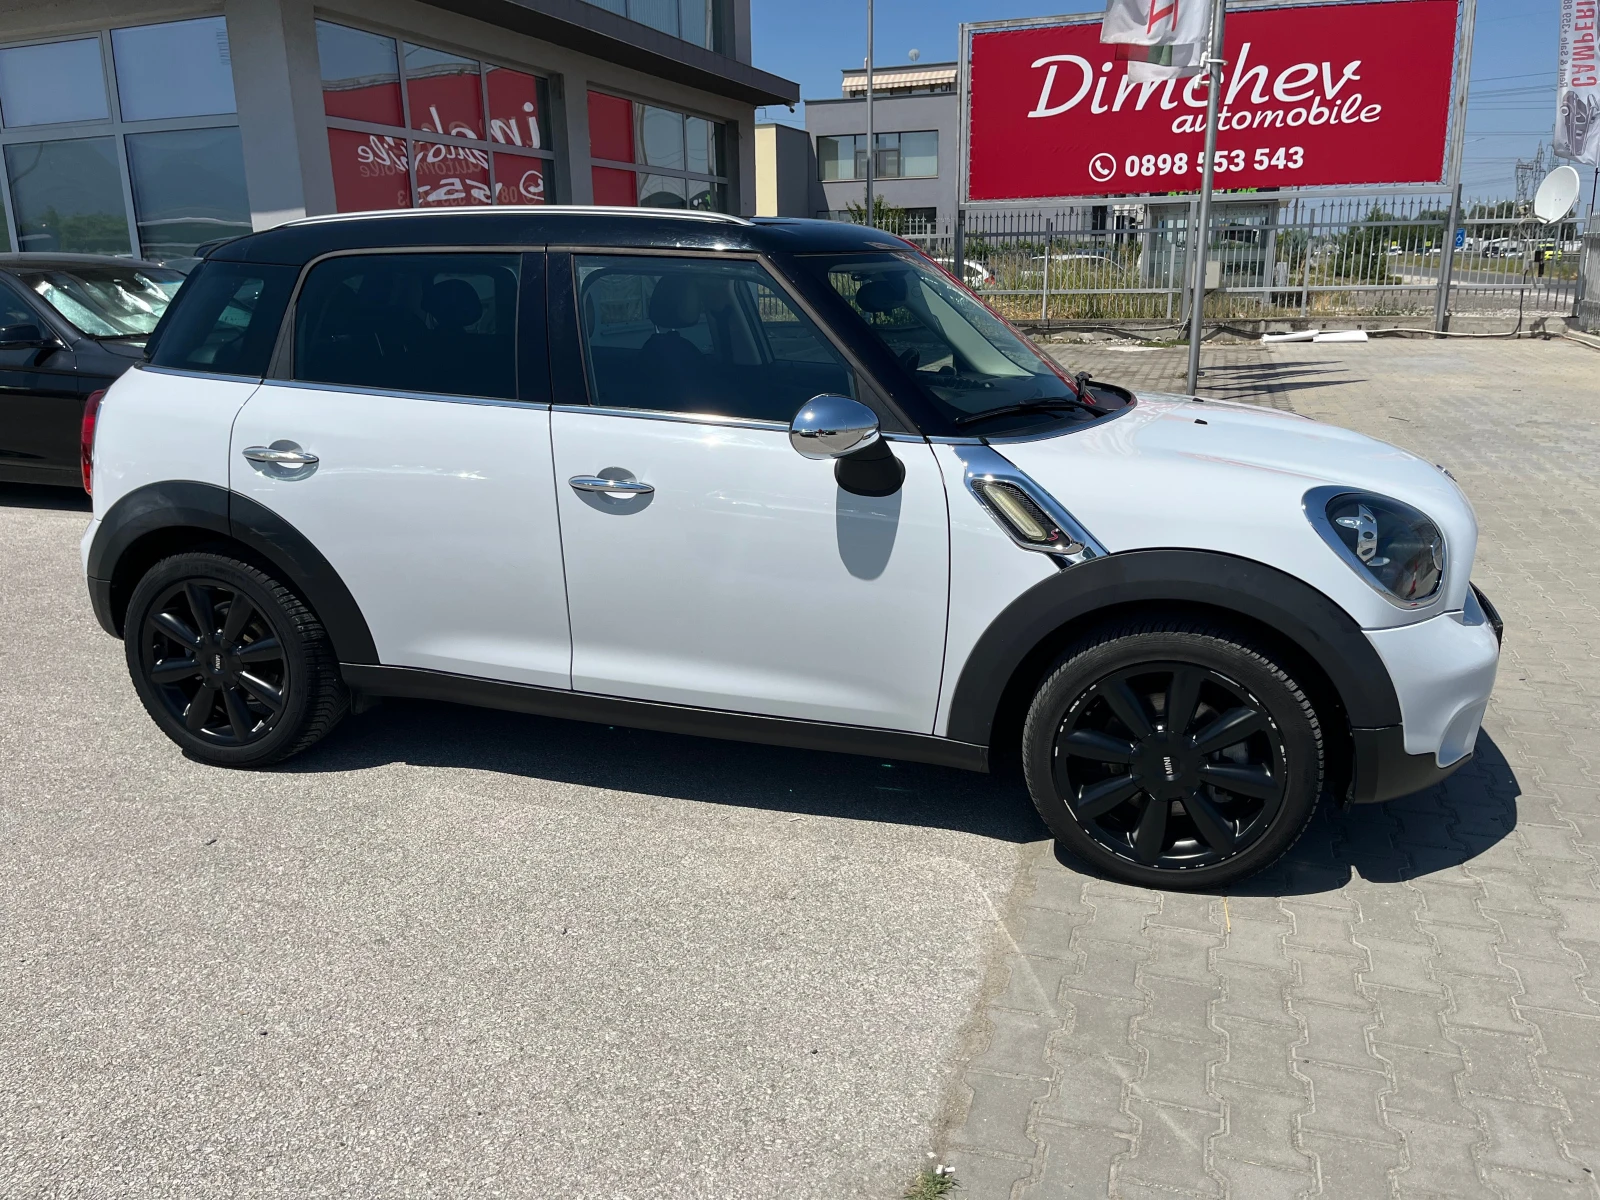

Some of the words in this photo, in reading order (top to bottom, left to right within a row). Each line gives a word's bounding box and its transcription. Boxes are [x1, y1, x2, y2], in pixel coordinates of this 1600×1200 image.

[1124, 152, 1188, 178] 0898
[1253, 146, 1305, 171] 543
[1163, 756, 1173, 775] MINI
